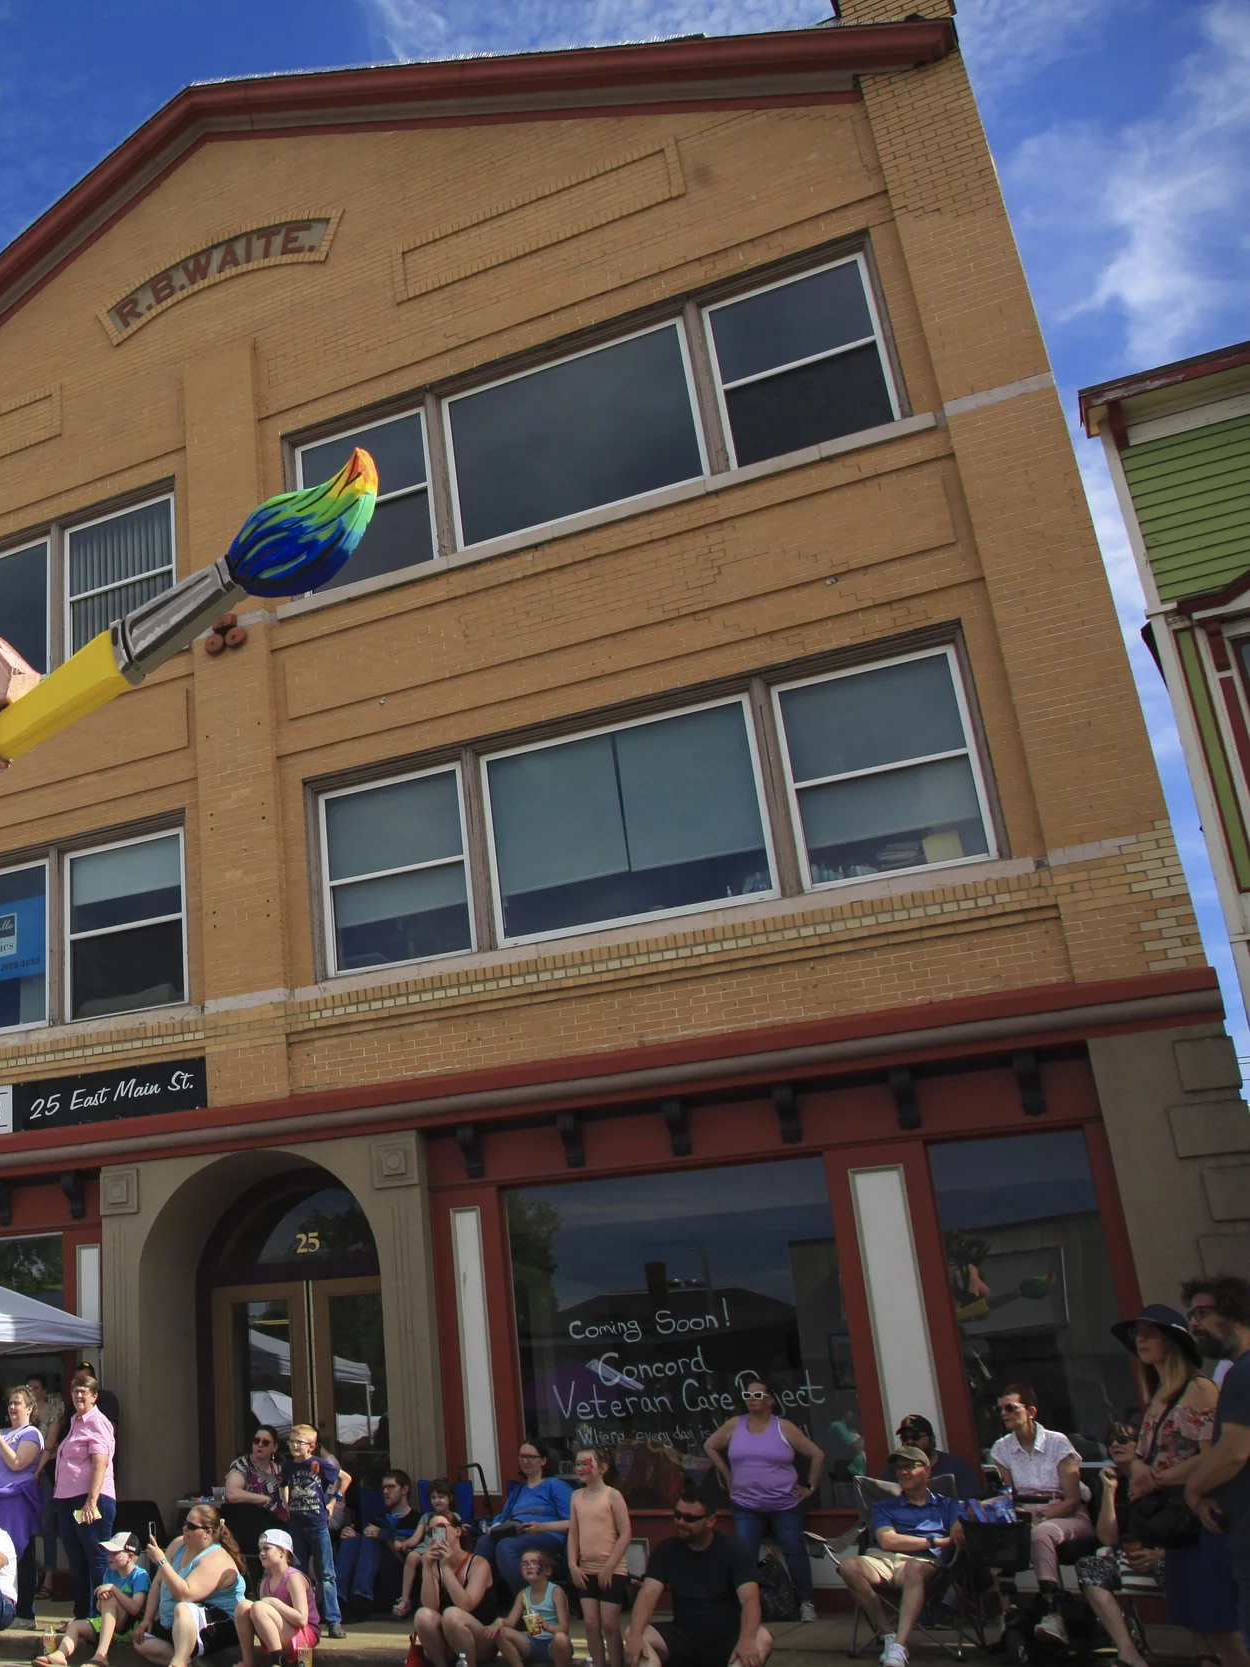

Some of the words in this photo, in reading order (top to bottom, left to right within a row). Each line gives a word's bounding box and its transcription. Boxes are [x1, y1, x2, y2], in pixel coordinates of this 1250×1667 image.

[29, 1093, 61, 1120] 25
[69, 1087, 111, 1111] East
[113, 1078, 161, 1102] Main
[167, 1070, 195, 1091] St.
[296, 1232, 320, 1254] 25
[568, 1318, 642, 1343] Coming
[598, 1345, 714, 1386] Concord
[552, 1380, 674, 1420] Veteran
[682, 1378, 735, 1412] Care
[577, 1425, 625, 1446] Where
